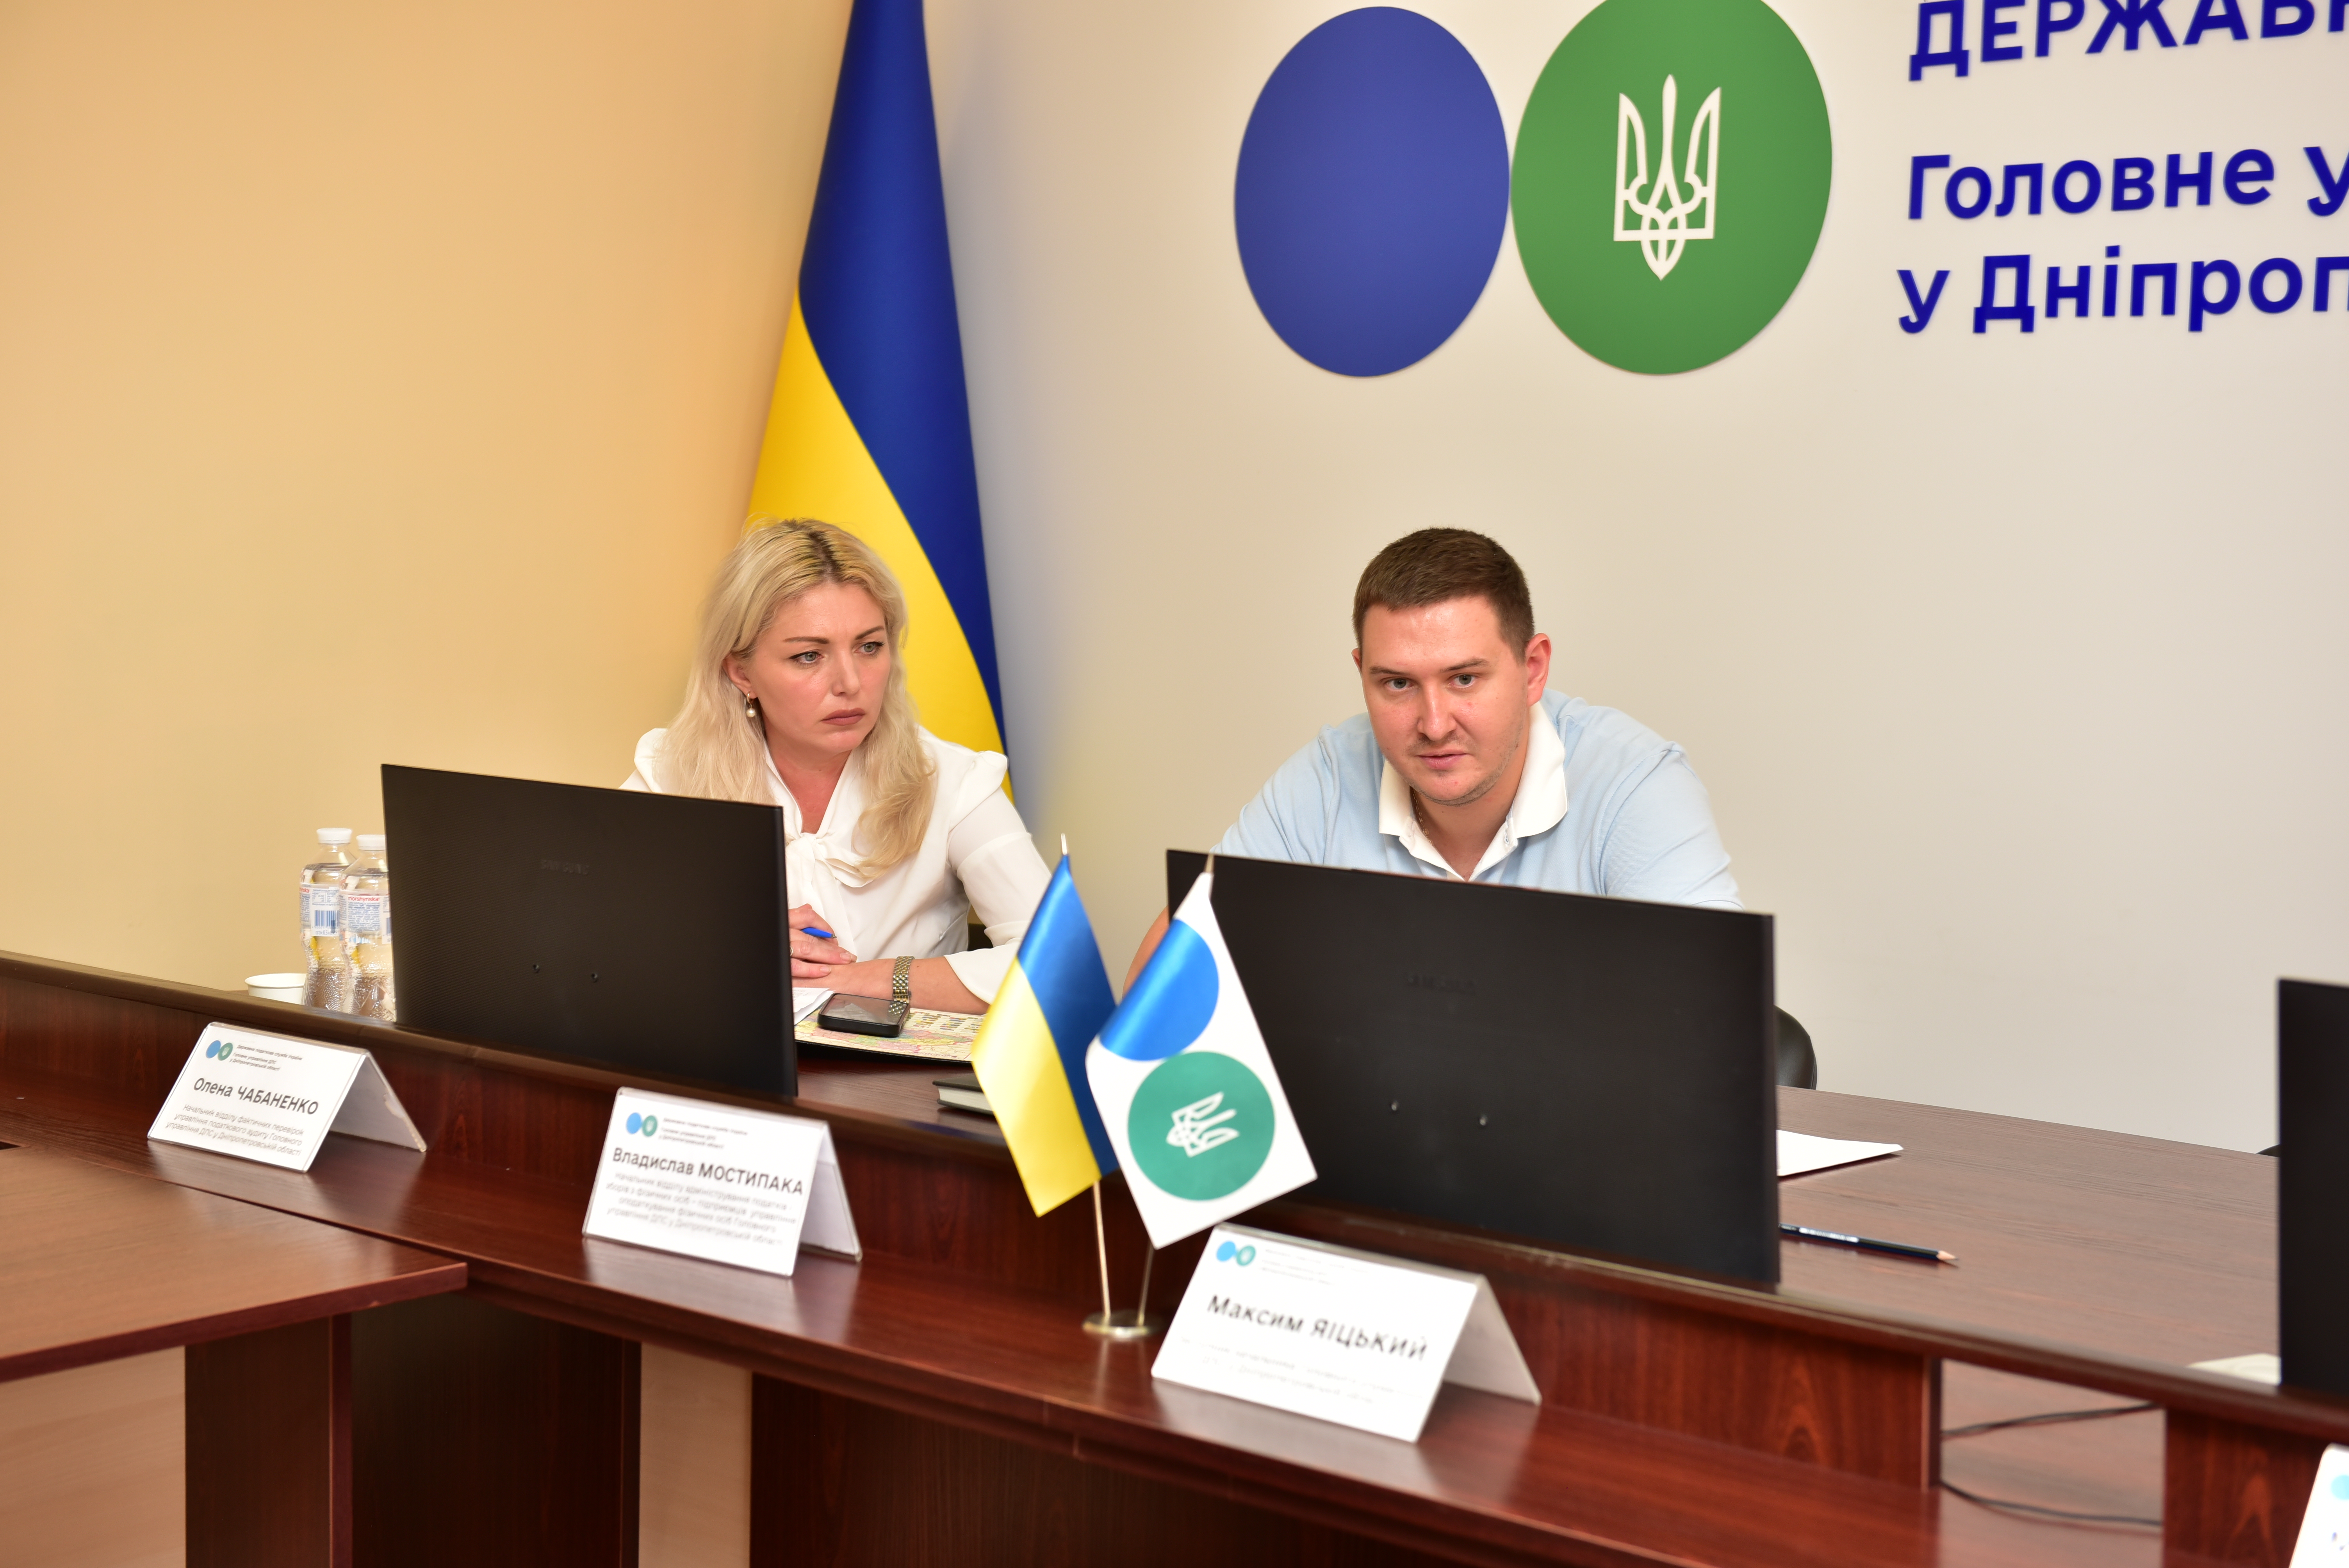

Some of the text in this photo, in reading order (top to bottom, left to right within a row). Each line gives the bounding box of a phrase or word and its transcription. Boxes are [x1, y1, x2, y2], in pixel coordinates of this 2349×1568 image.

[1908, 0, 2349, 81] ДЕРЖАВ
[1908, 148, 2274, 219] Головне
[1896, 244, 2349, 334] у Дніпроп
[183, 1104, 305, 1135] Начальник відділу фактичних перевірок
[194, 1078, 319, 1115] Олена ЧАБАНЕНКО
[165, 1121, 200, 1133] управління
[199, 1128, 214, 1136] ДПС
[217, 1132, 277, 1150] Дніпропетровській
[277, 1146, 302, 1156] області
[174, 1113, 303, 1146] управління податкового аудиту Головного
[613, 1147, 804, 1195] Владислав МОСТИПАКА
[1207, 1295, 1428, 1361] Максим ЯІЦЬКИЙ
